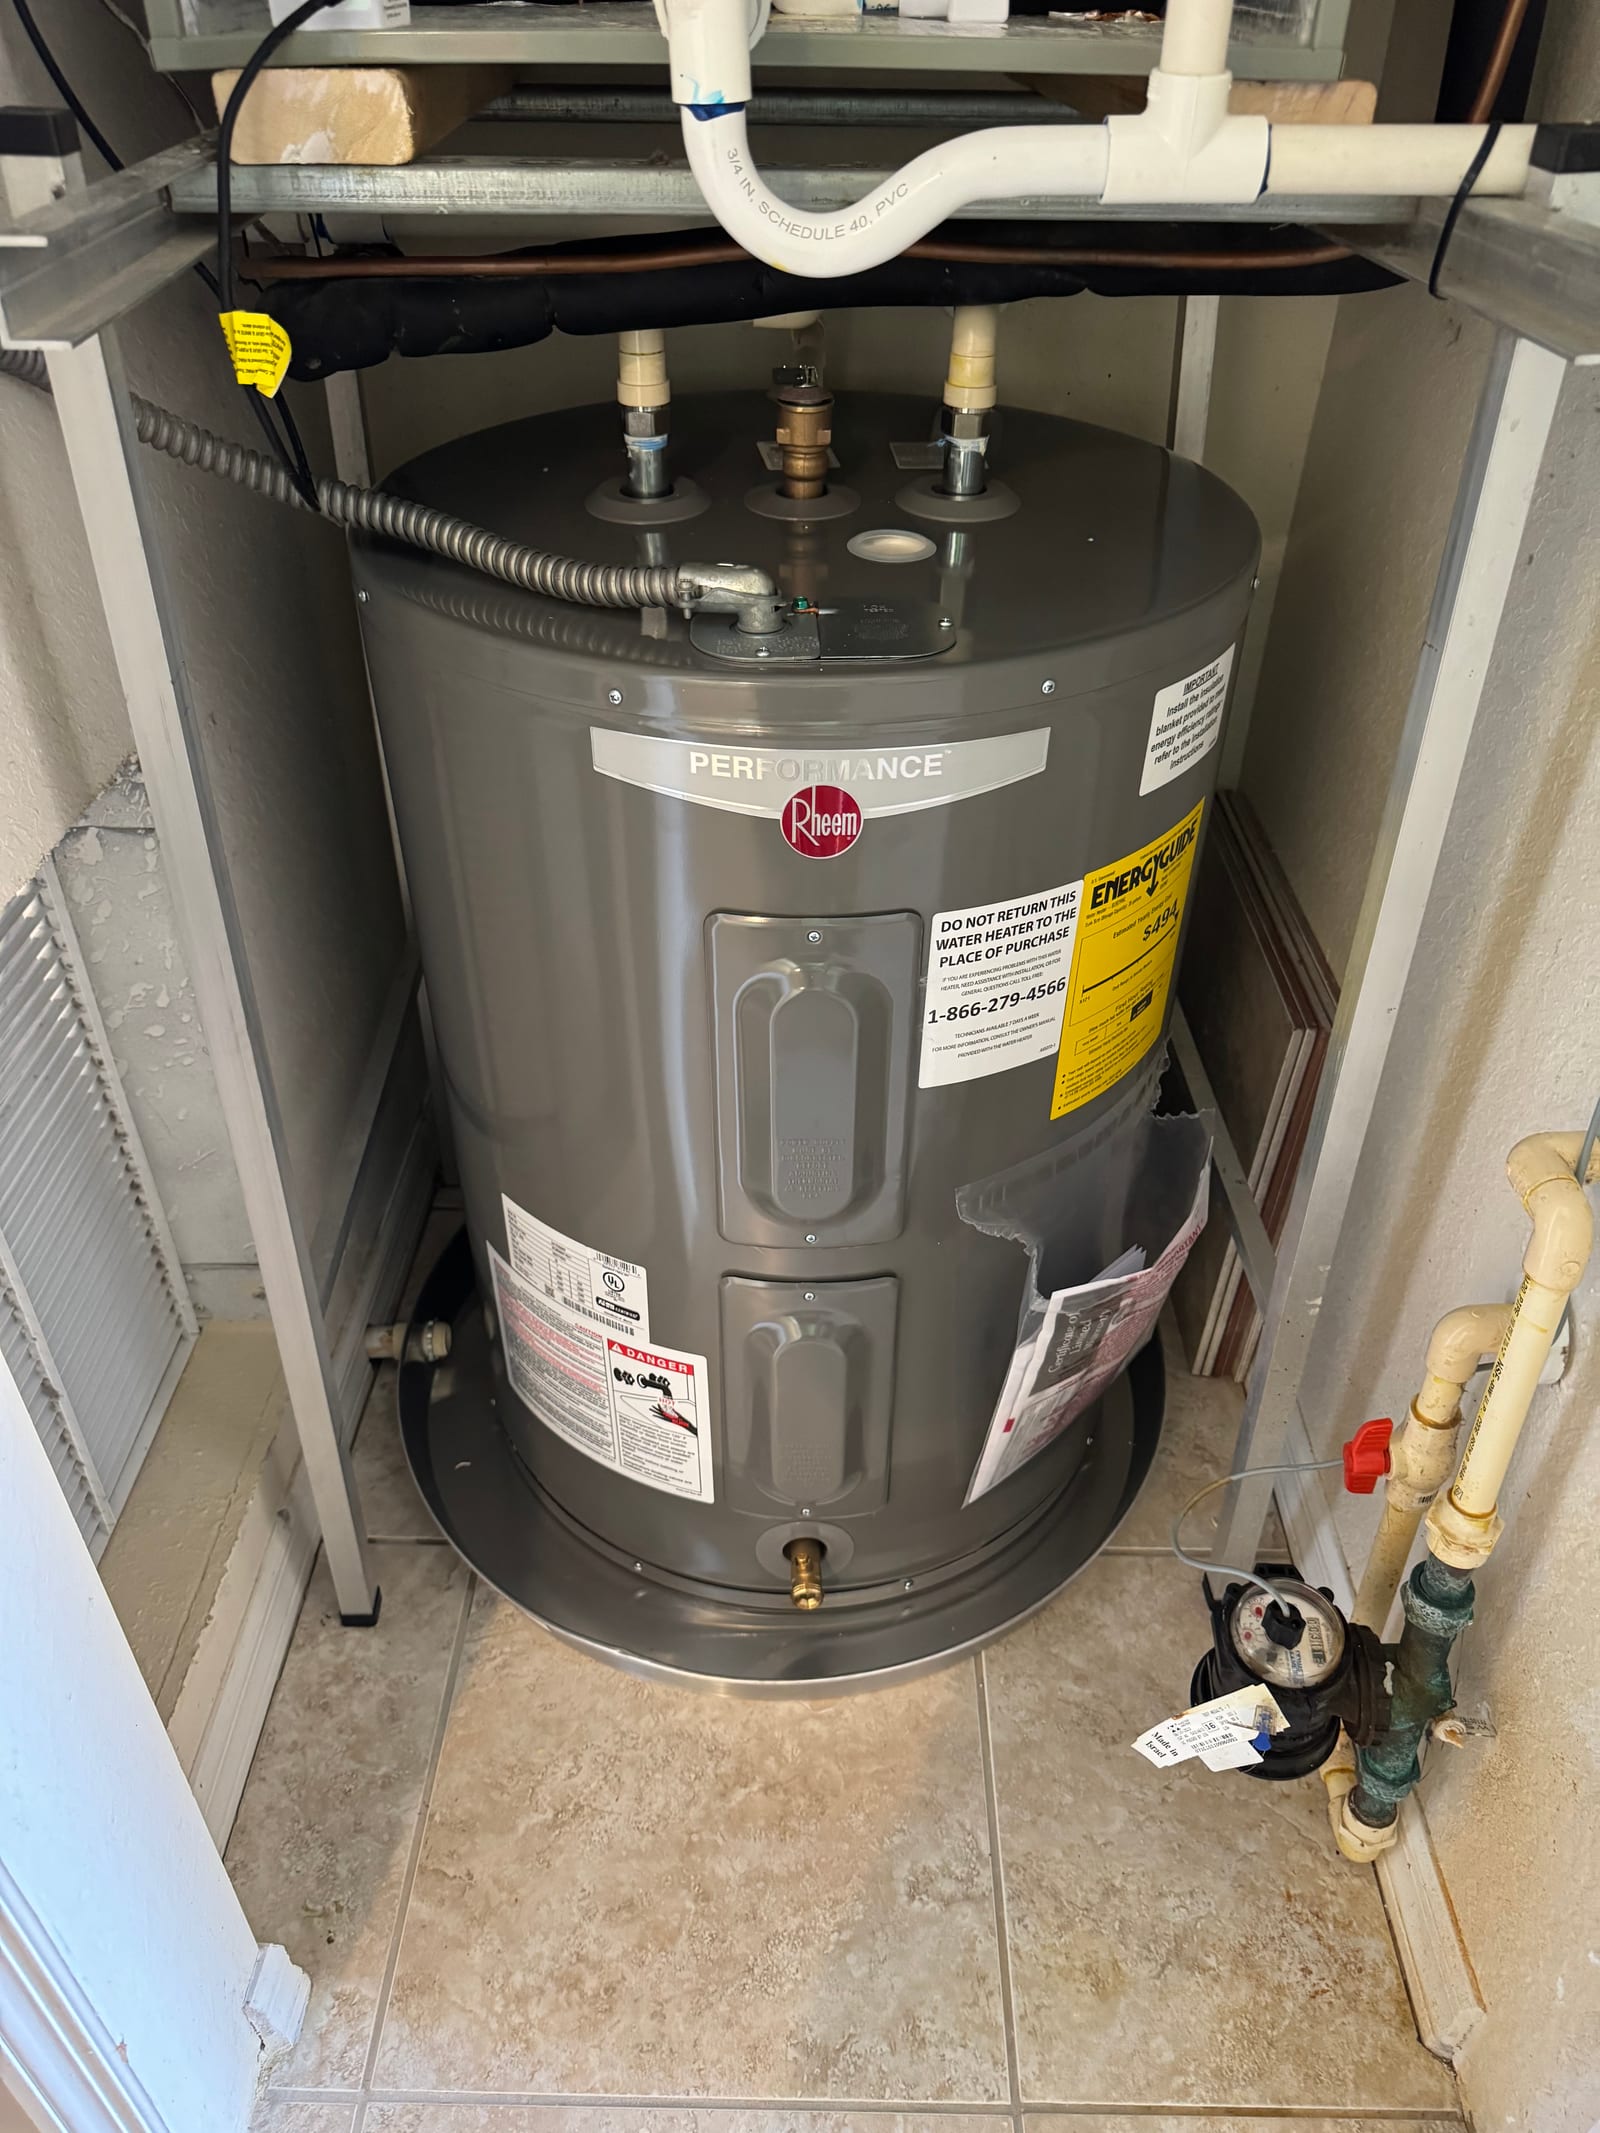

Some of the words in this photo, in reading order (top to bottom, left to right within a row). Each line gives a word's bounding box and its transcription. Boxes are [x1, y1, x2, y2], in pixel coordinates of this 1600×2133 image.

[728, 148, 743, 175] 3/4
[759, 201, 846, 241] SCHEDULE
[875, 183, 910, 217] PVC
[1183, 662, 1220, 696] IMPORTANT
[1155, 716, 1183, 736] blanket
[1183, 697, 1209, 725] provided
[1167, 698, 1189, 717] Install
[1189, 694, 1199, 705] the
[1151, 734, 1176, 752] energy
[1177, 715, 1205, 739] efficiency
[1154, 750, 1172, 765] refer
[1181, 739, 1191, 750] the
[791, 785, 857, 846] Rheem
[941, 919, 963, 933] DO
[966, 913, 995, 929] NOT
[997, 899, 1049, 923] RETURN
[1050, 890, 1077, 908] THIS
[1143, 898, 1178, 941] $494
[936, 933, 982, 951] WATER
[985, 921, 1034, 942] HEATER
[1036, 915, 1052, 929] TO
[1054, 907, 1077, 924] THE
[939, 950, 982, 968] PLACE
[985, 945, 1003, 959] OF
[1005, 926, 1070, 955] PURCHASE
[961, 988, 982, 996] GENERAL
[983, 982, 1009, 992] QUESTIONS
[1021, 975, 1032, 983] TOLL
[974, 975, 1002, 985] ASSISTANCE
[927, 977, 1066, 1024] 1-866-279-4566
[955, 1028, 985, 1038] TECHNICIANS
[990, 1031, 1011, 1041] CONSULT
[957, 1048, 982, 1058] PROVIDED
[627, 1349, 688, 1373] DANGER
[1048, 1327, 1074, 1372] Certificate
[1205, 1722, 1216, 1732] 16
[1146, 1741, 1166, 1758] Israel
[1152, 1732, 1171, 1750] Made
[1170, 1748, 1179, 1757] in
